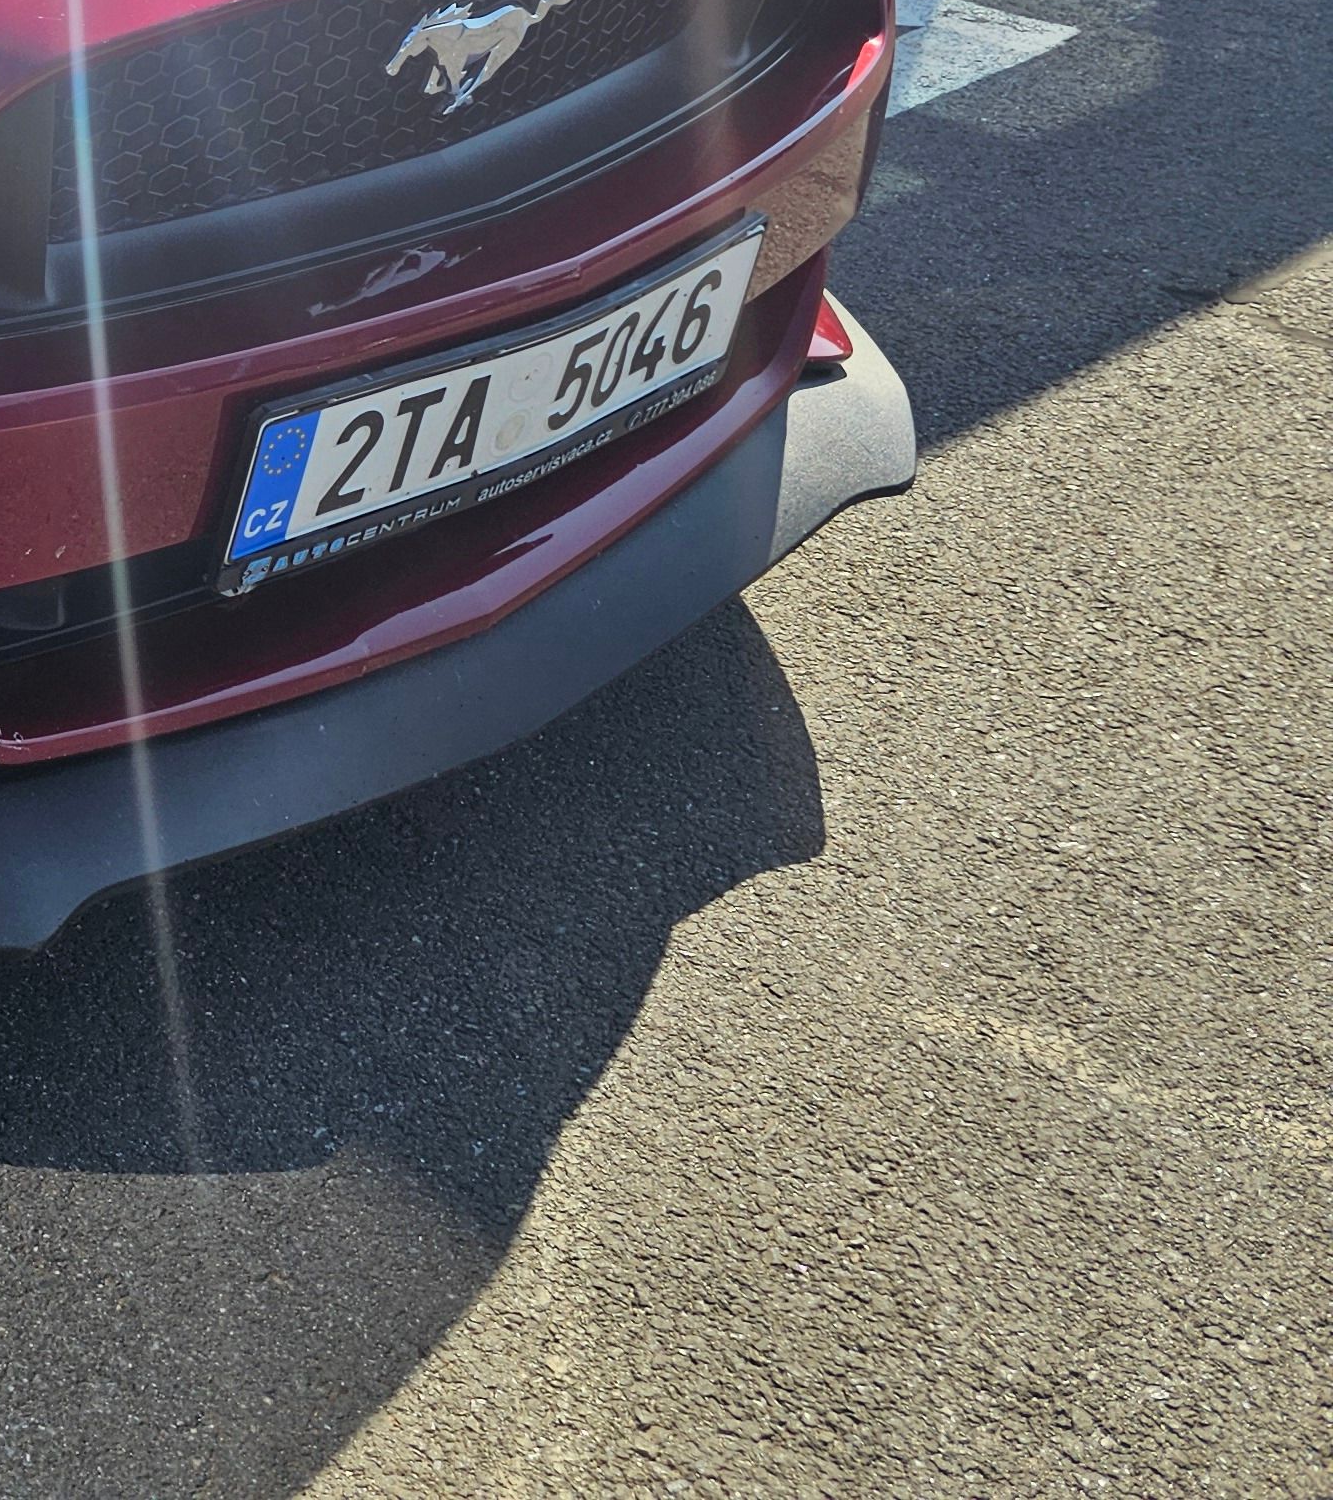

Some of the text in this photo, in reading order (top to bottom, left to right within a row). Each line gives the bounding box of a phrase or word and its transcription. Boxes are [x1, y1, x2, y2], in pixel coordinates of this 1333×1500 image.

[315, 269, 723, 517] 2TA 5046
[243, 499, 289, 540] CZ
[271, 496, 462, 573] AUTOCENTRUM
[477, 428, 614, 502] autoservisvaca.cz
